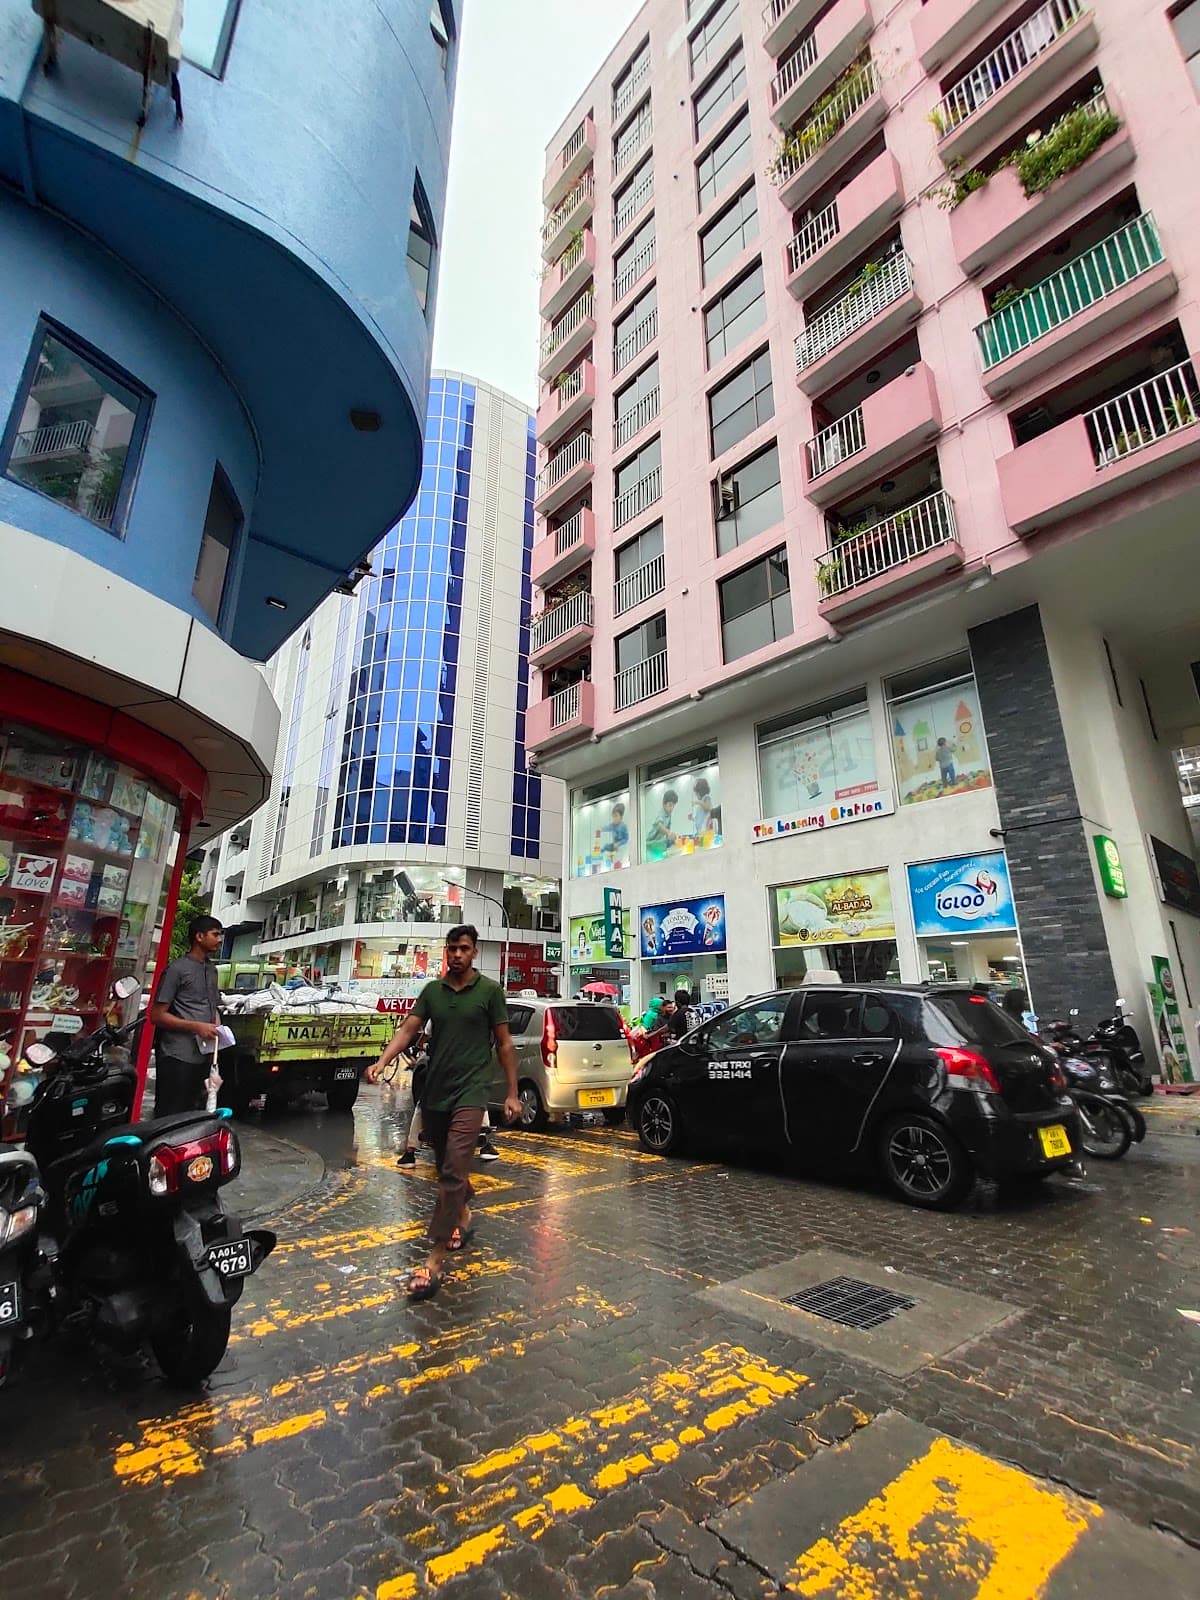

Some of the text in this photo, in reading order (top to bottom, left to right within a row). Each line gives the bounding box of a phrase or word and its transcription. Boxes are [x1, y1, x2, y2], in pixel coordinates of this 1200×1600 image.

[753, 801, 883, 837] The Learning Station
[16, 874, 49, 889] Love
[609, 892, 622, 942] MHA
[708, 1061, 751, 1070] FINE TAXI
[708, 1070, 752, 1079] 3321414
